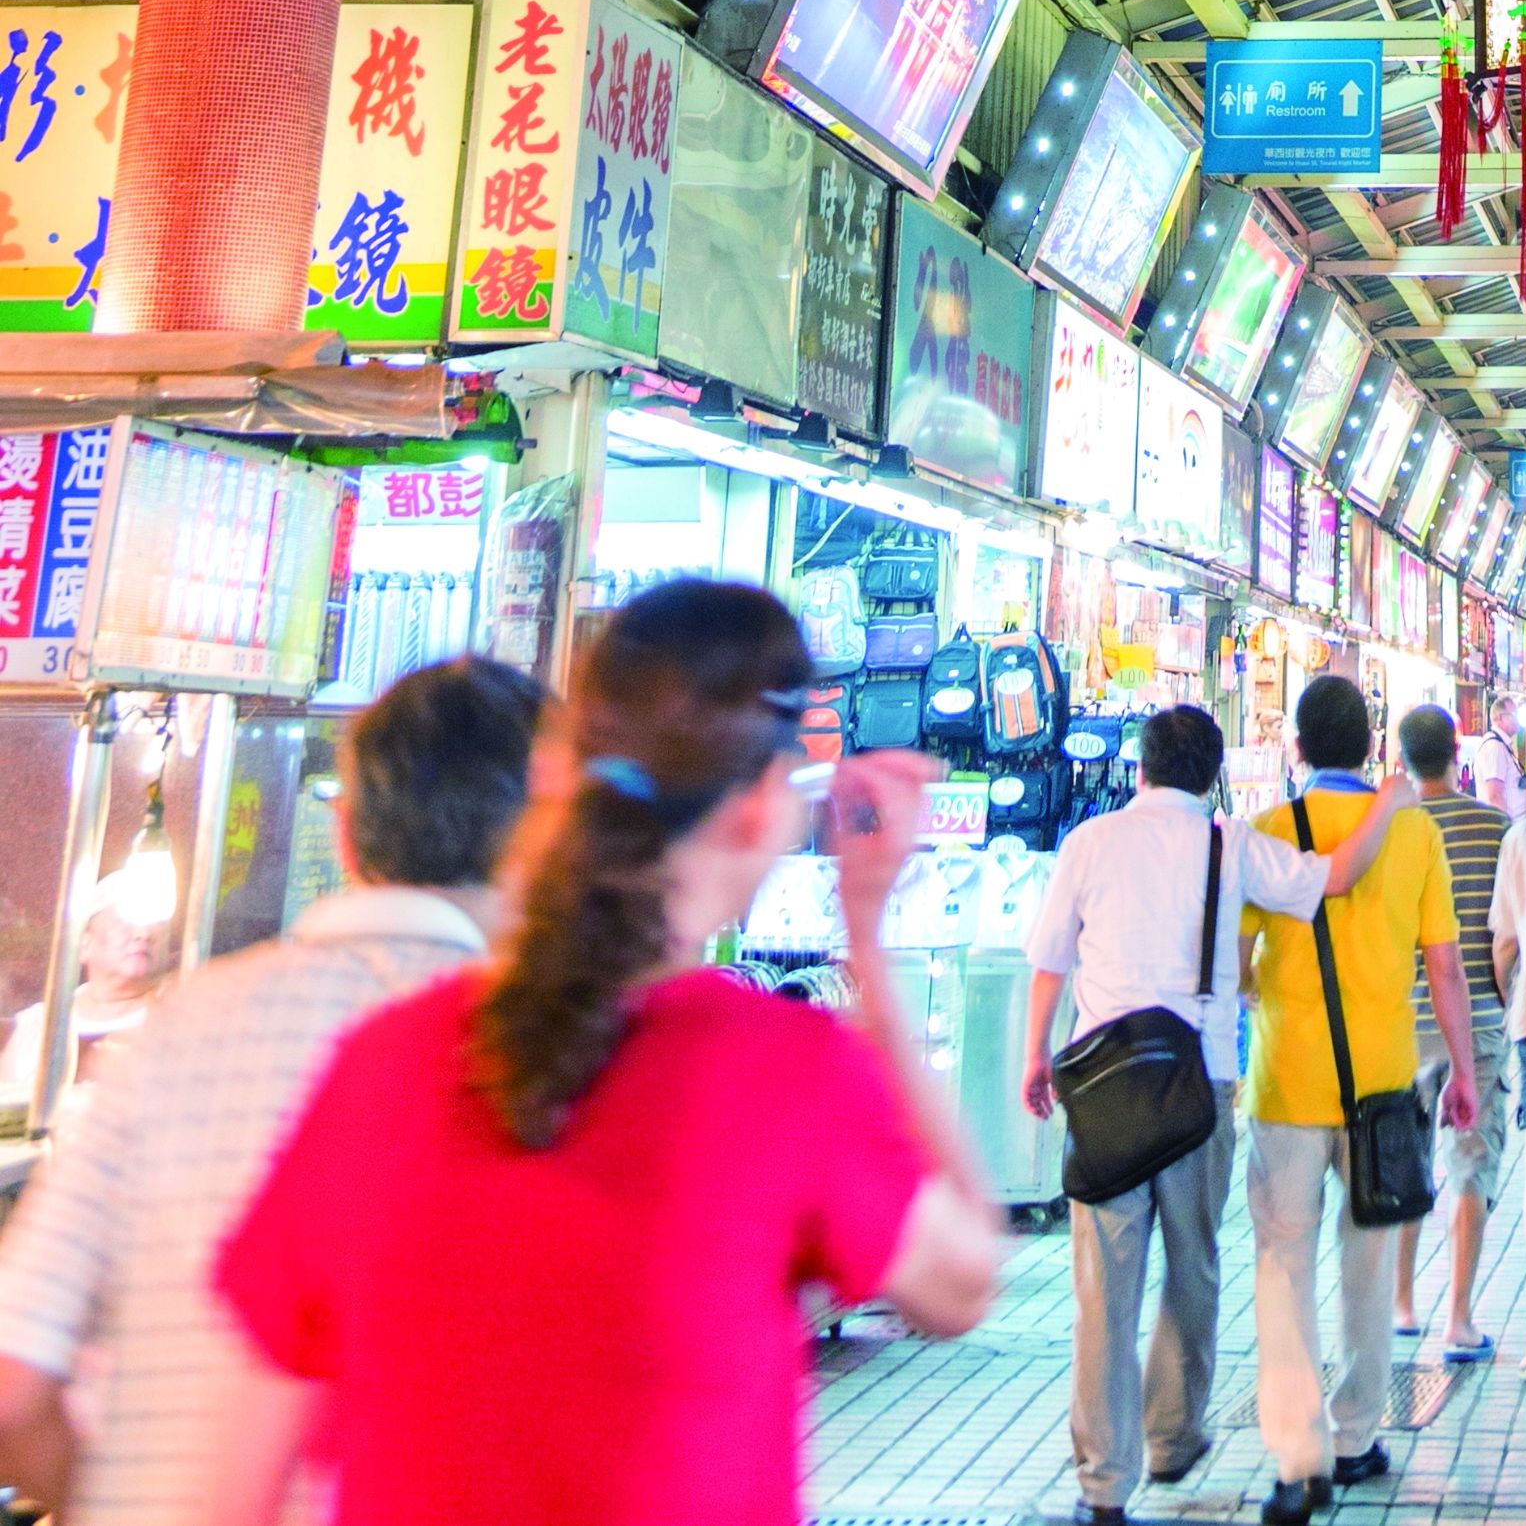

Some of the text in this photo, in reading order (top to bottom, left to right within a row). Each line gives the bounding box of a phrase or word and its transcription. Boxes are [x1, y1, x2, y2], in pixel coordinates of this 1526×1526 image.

[585, 22, 673, 175] 太陽眼鏡
[1265, 105, 1326, 117] Restroom
[470, 0, 565, 322] 老花眼鏡
[574, 154, 656, 334] 皮件
[1119, 669, 1146, 683] 100
[1071, 738, 1101, 755] 100
[931, 795, 984, 832] 390
